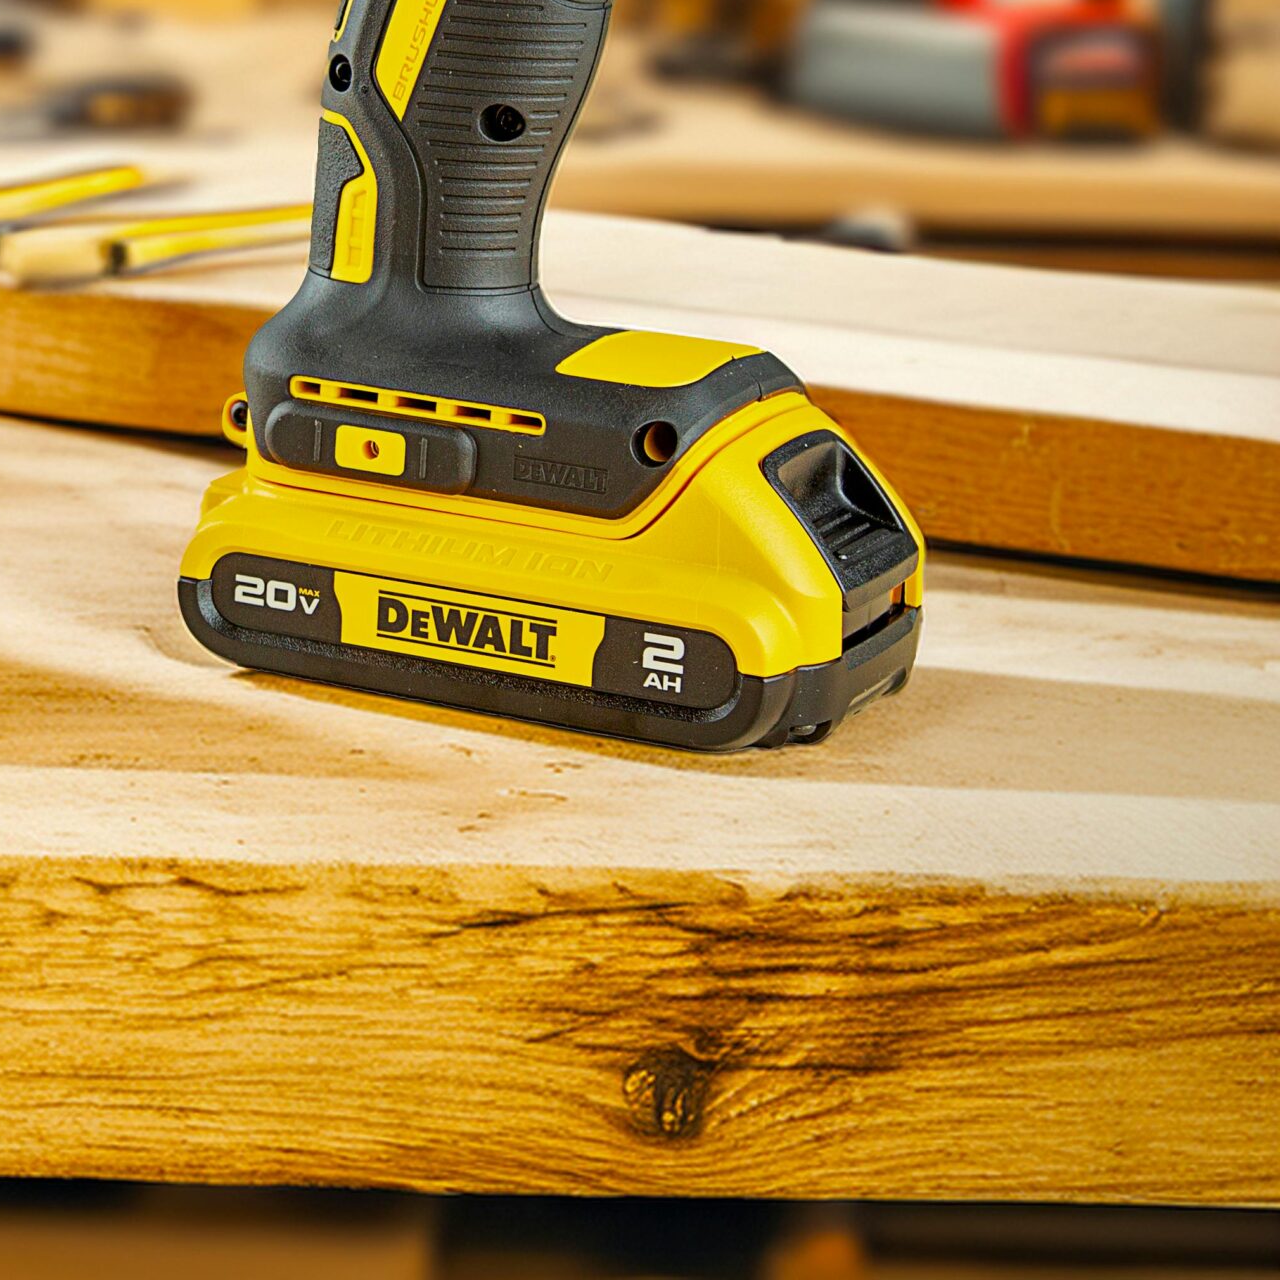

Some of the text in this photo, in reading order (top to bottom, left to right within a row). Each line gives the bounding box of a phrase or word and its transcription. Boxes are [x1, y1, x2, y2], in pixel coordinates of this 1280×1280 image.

[326, 520, 613, 582] LITHIUM ION
[298, 587, 320, 597] MAX
[642, 632, 685, 674] 2
[643, 672, 681, 693] AH
